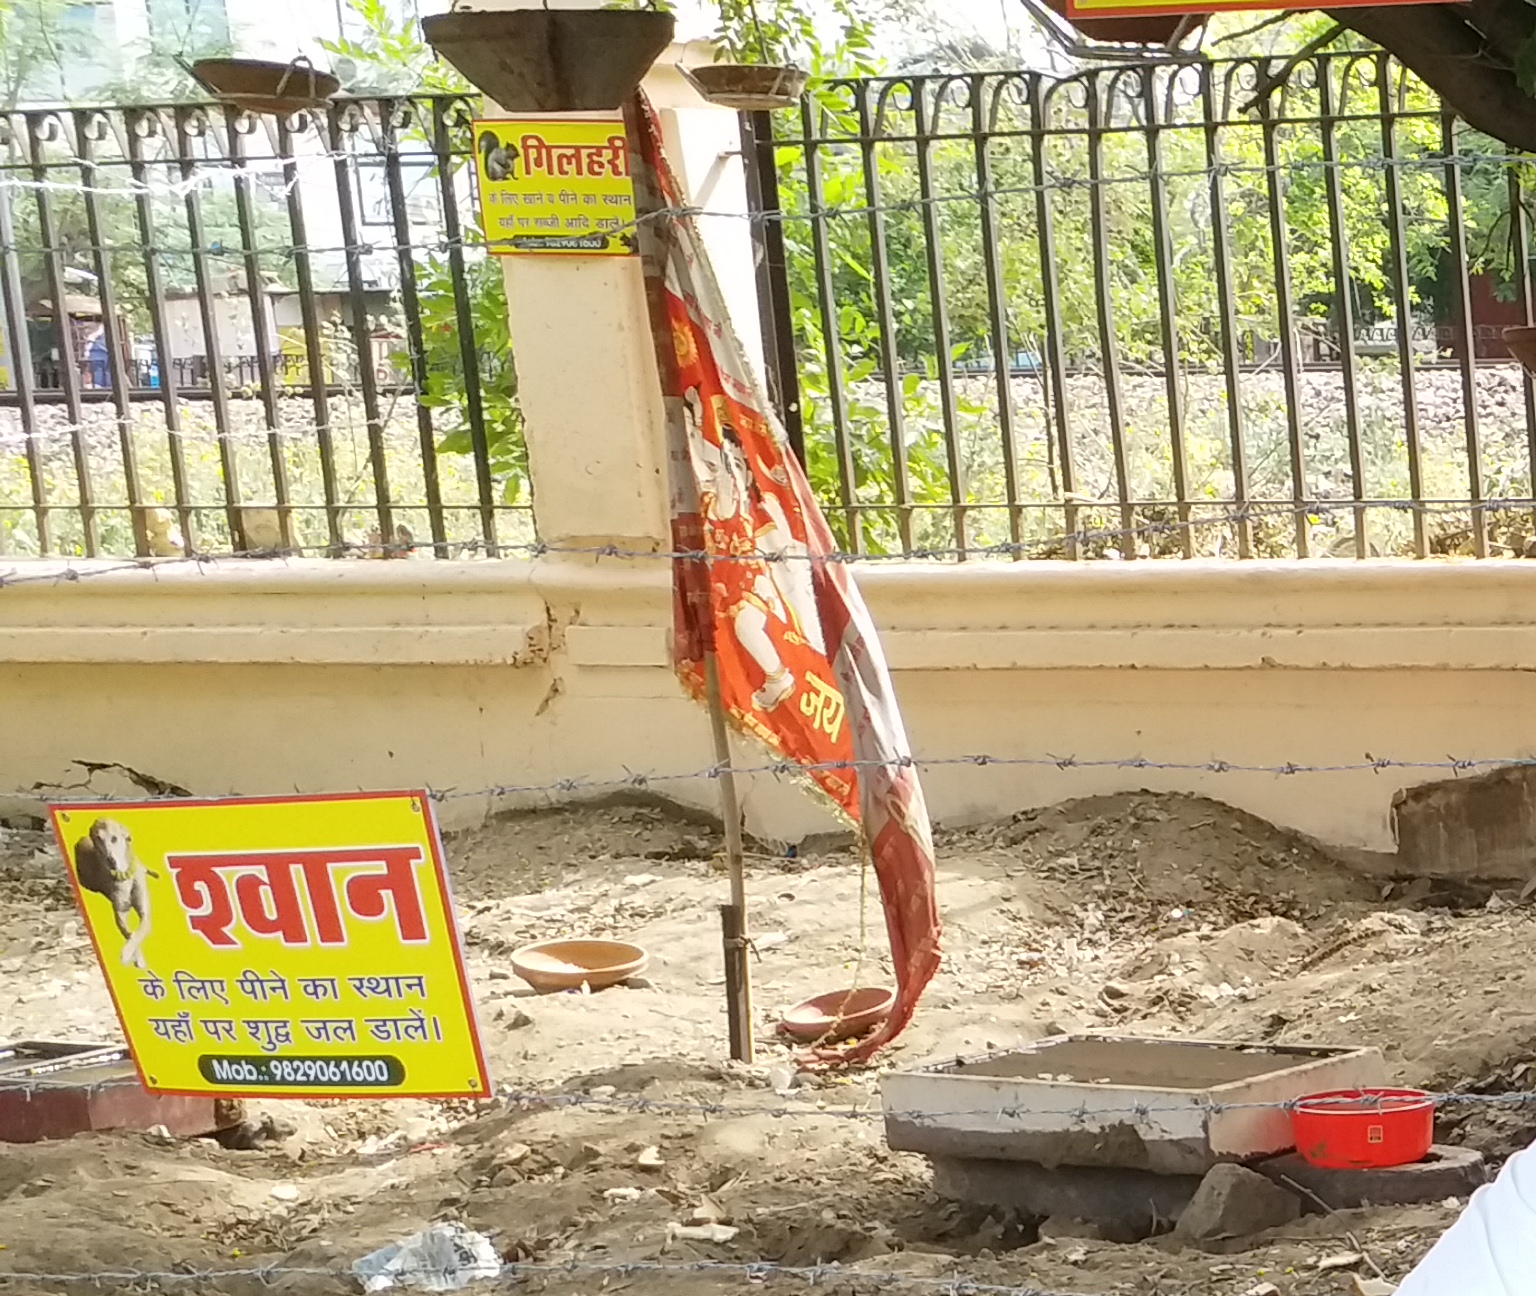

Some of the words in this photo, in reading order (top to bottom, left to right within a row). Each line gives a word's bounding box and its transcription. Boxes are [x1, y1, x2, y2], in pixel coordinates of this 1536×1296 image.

[520, 134, 630, 177] गिलहरी
[582, 193, 598, 205] का
[601, 193, 632, 206] स्थान
[564, 213, 590, 229] आदि
[800, 669, 845, 745] जय
[165, 845, 429, 946] श्वान
[137, 969, 166, 1000] के
[172, 969, 230, 1005] लिए
[236, 969, 290, 1001] पीने
[297, 976, 339, 1001] का
[347, 974, 427, 999] स्थान
[148, 1011, 195, 1043] यहाँ
[199, 1018, 238, 1042] पर
[299, 1018, 357, 1042] जल
[270, 1058, 389, 1083] 9829061600
